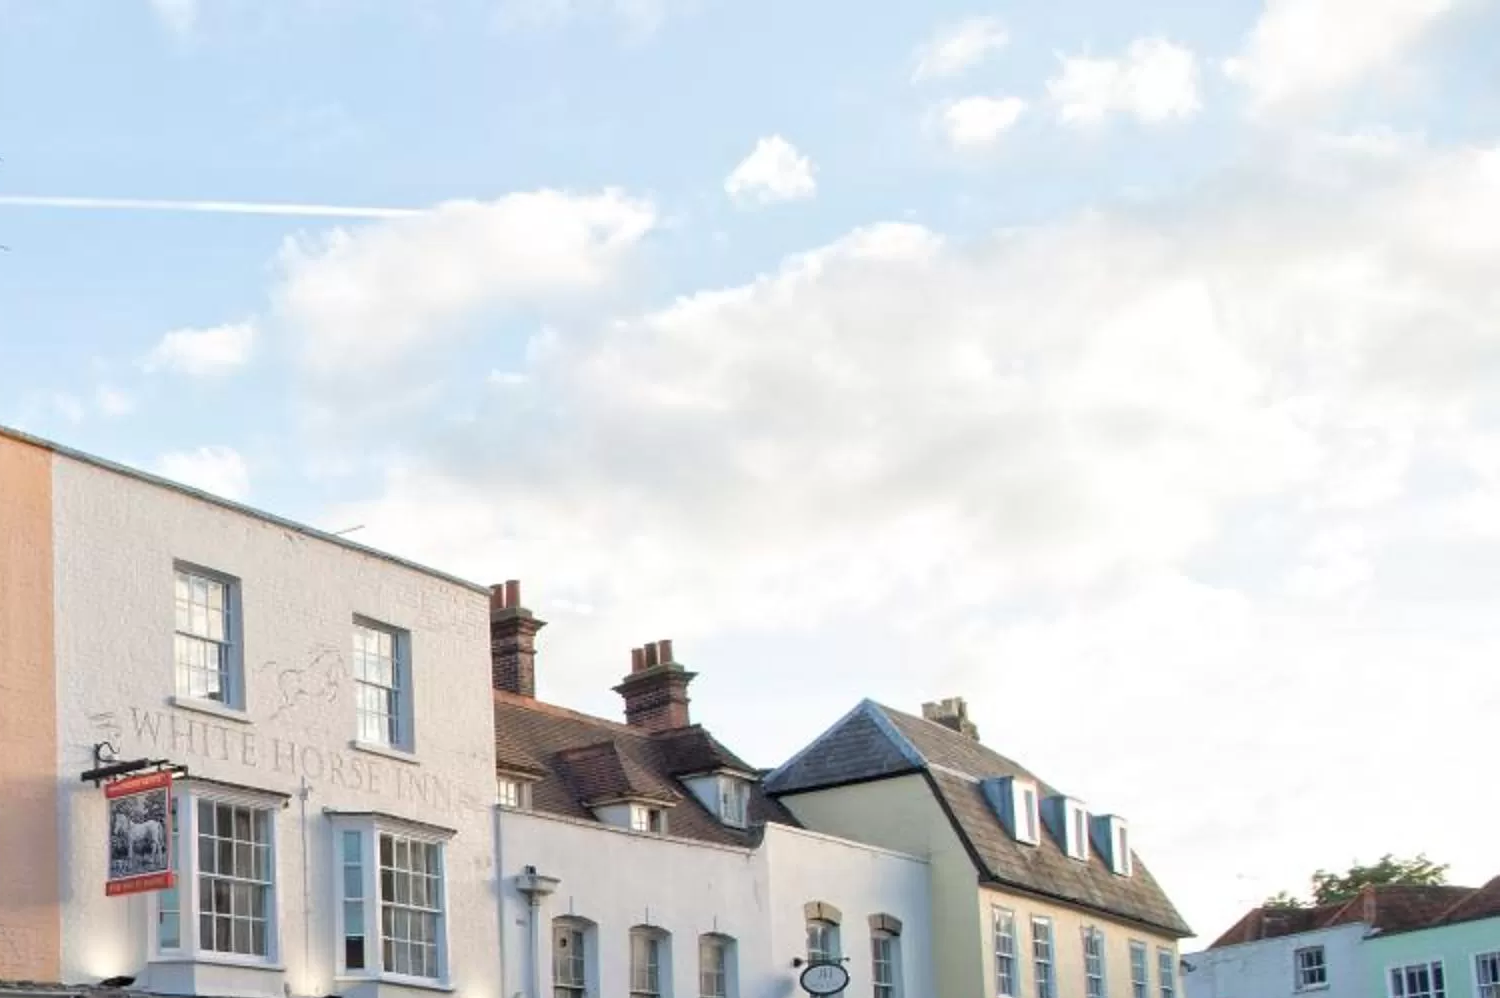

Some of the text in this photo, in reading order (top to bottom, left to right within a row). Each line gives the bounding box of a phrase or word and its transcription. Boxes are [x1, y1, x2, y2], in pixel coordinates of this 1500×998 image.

[131, 706, 454, 807] WHITE HORSE INN
